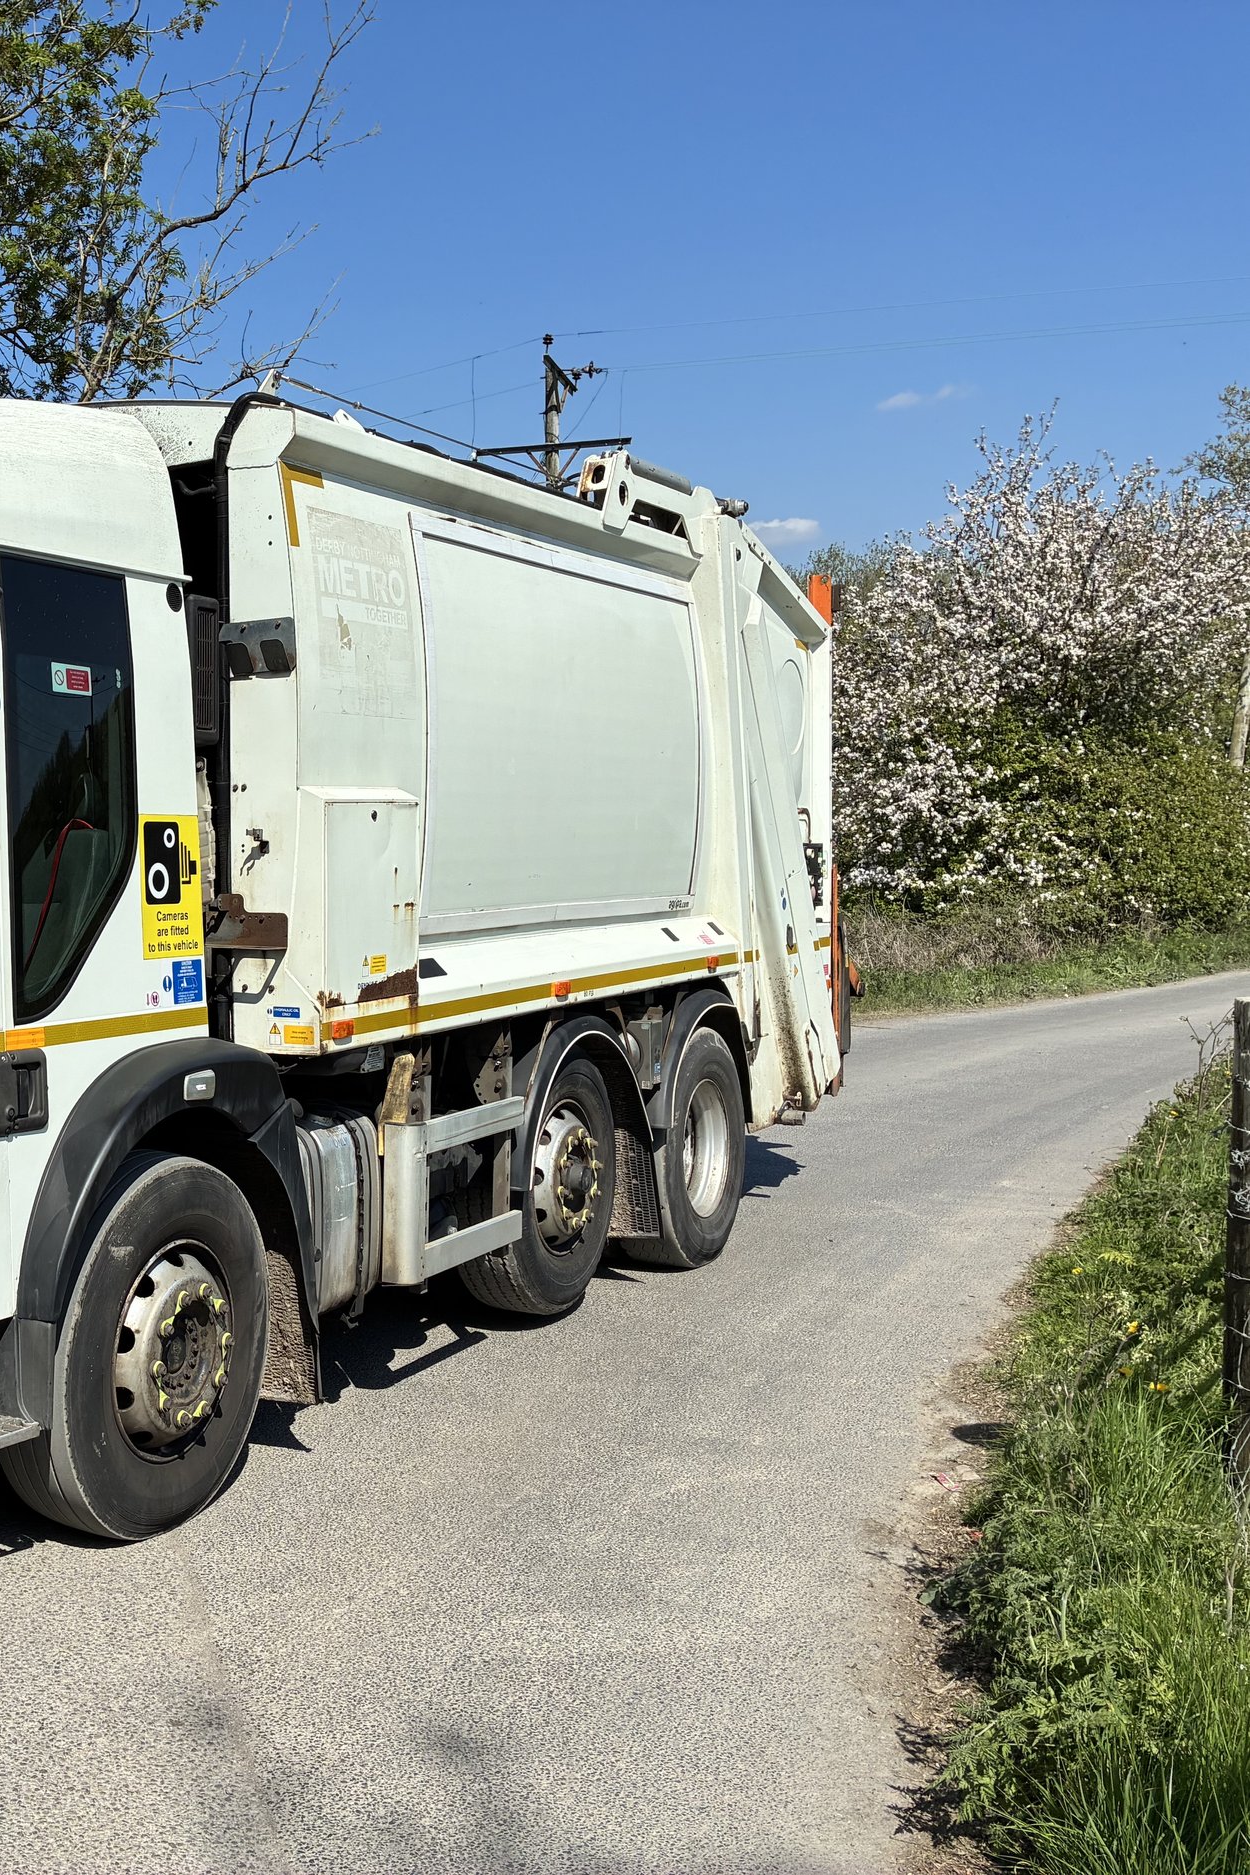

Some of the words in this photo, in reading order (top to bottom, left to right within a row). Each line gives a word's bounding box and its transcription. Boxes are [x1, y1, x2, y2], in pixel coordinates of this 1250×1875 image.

[315, 536, 346, 556] DERBY
[317, 554, 406, 608] METRO
[365, 606, 407, 626] TOGETHER
[156, 911, 189, 921] Cameras
[156, 928, 169, 937] are
[170, 925, 189, 936] fitted
[148, 942, 156, 953] to
[157, 940, 172, 952] this
[172, 939, 199, 951] vehicle
